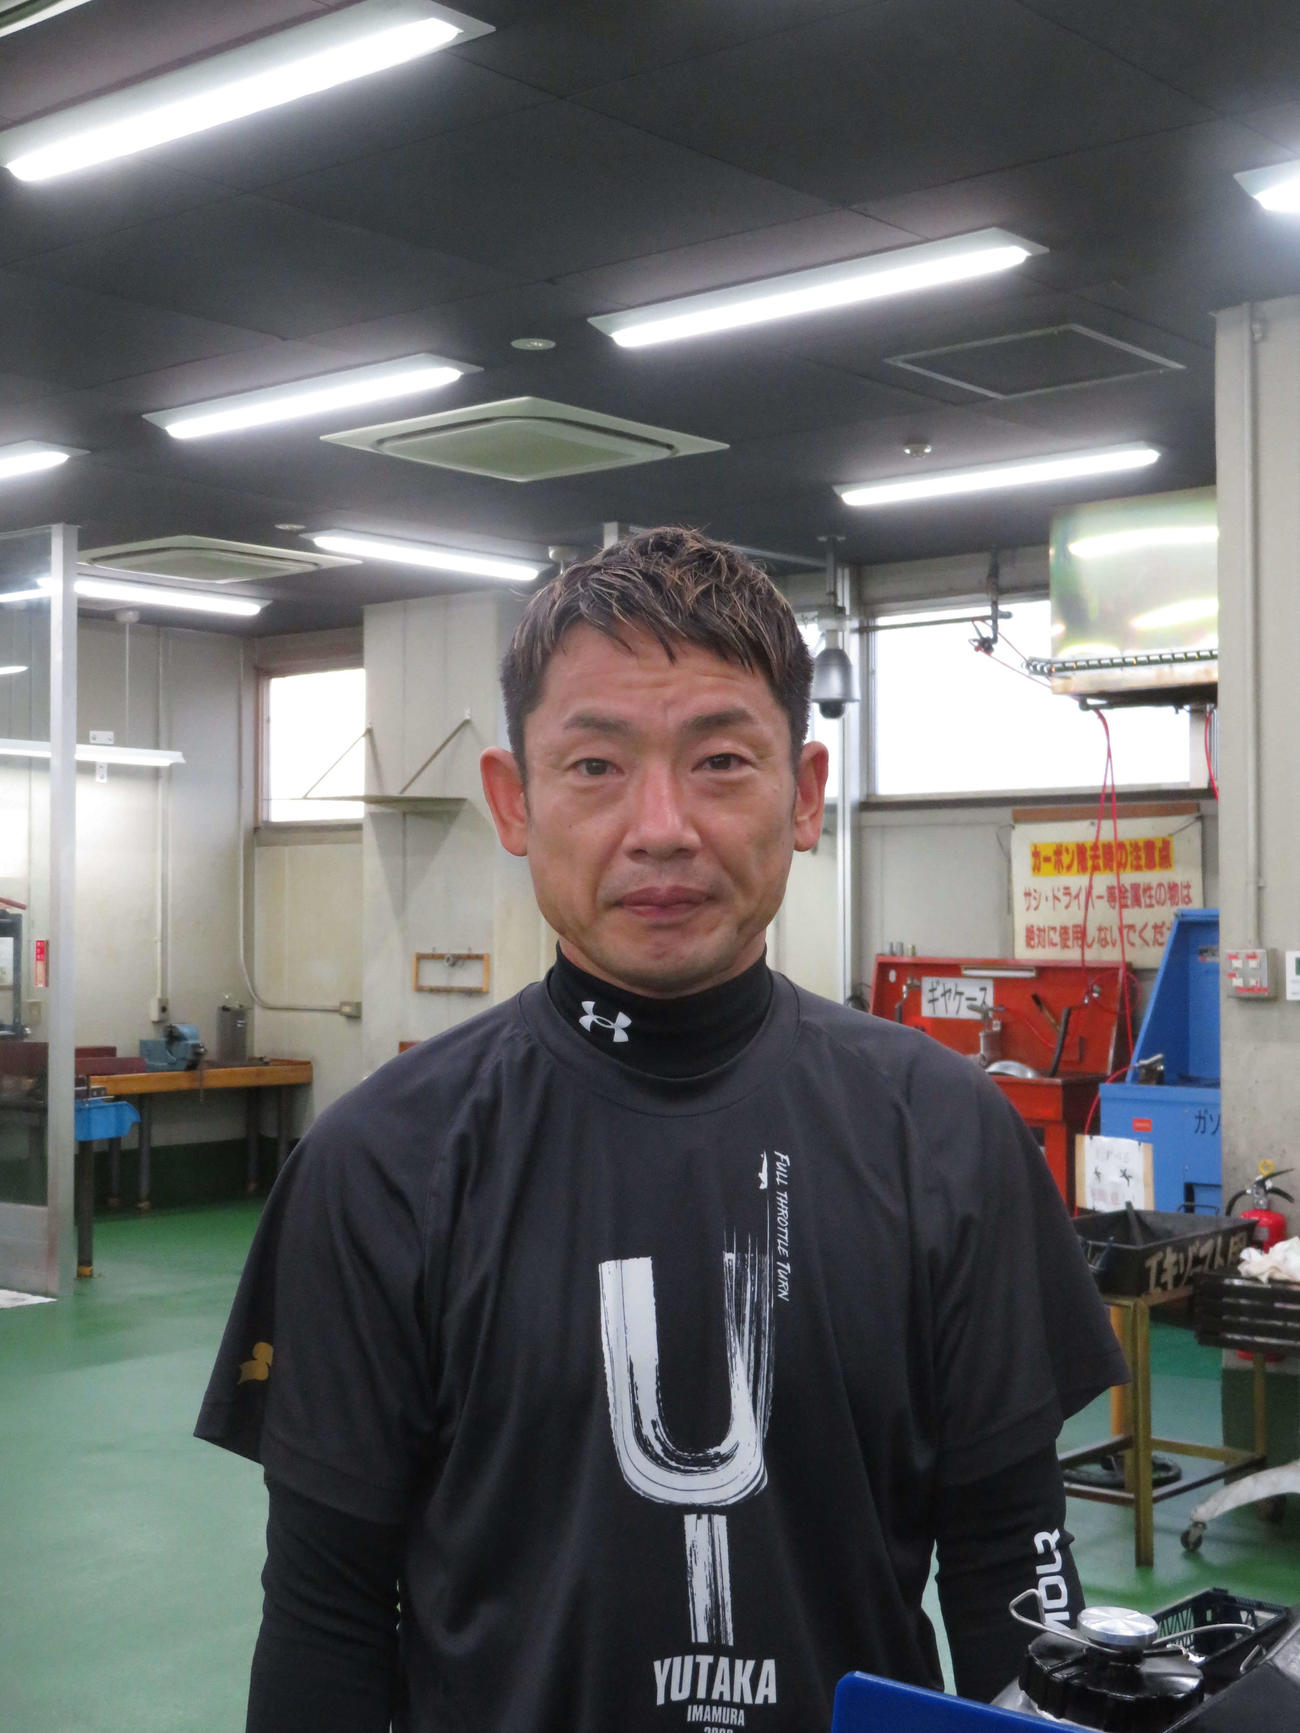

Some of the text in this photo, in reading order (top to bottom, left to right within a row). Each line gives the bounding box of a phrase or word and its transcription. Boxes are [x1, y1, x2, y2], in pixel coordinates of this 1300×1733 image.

[1025, 921, 1173, 949] 絶対に使用しないでくだ
[774, 1150, 791, 1302] FULL THROTTLE TURN
[653, 1654, 777, 1706] YUTAKA
[687, 1704, 745, 1727] IMAMURA
